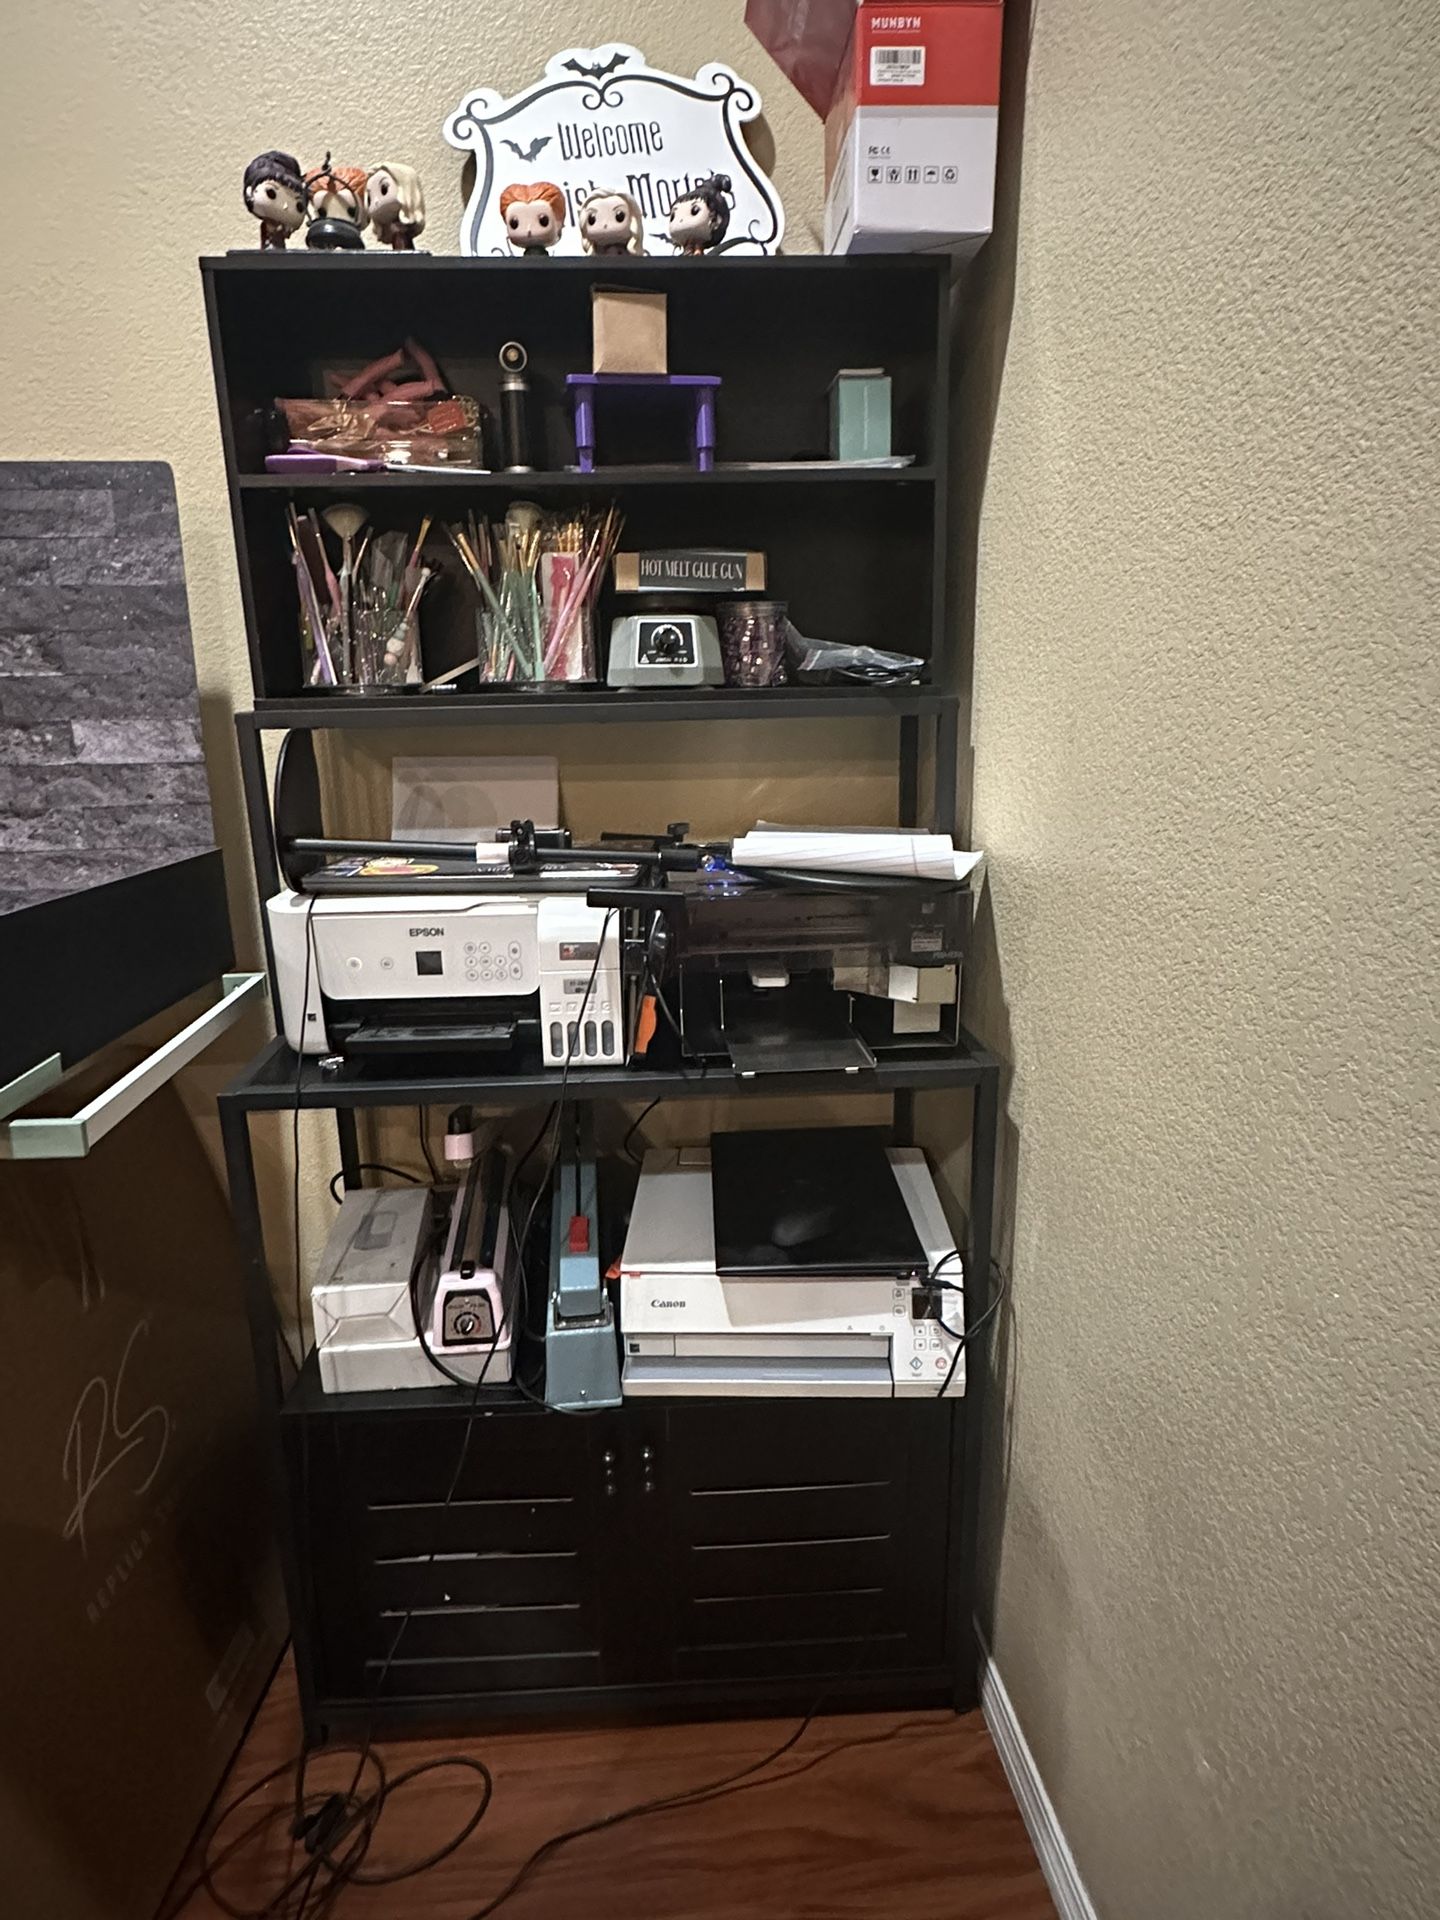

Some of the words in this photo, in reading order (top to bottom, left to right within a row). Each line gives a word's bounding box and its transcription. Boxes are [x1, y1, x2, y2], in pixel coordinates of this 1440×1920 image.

[557, 121, 663, 160] Welcome
[641, 559, 663, 577] HOT
[665, 560, 690, 577] MELT
[692, 561, 718, 579] GLUE
[720, 562, 743, 580] GUN
[409, 927, 445, 937] EPSON
[650, 1299, 686, 1308] Canon
